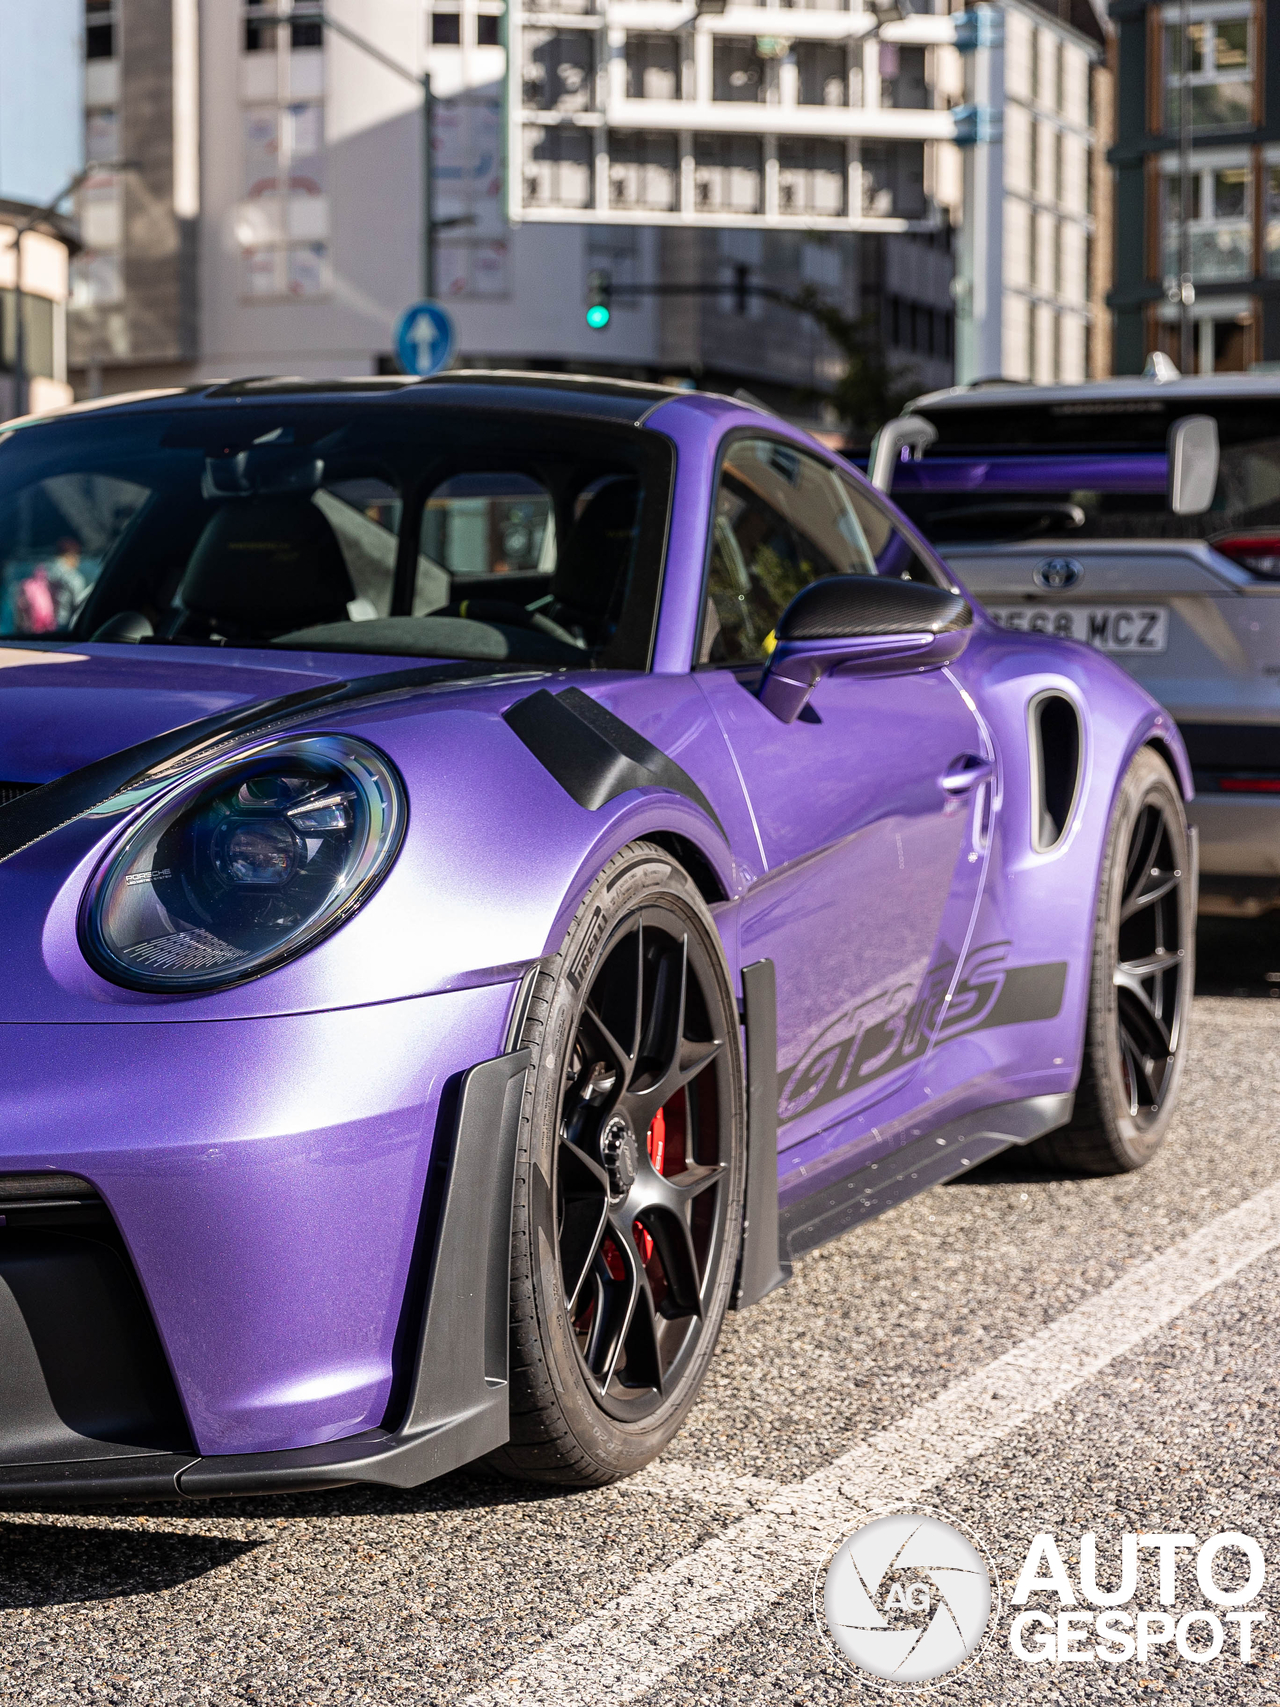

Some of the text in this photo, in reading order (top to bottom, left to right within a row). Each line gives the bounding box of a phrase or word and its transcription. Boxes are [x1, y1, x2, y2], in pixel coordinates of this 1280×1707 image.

[1087, 611, 1161, 647] MCZ
[125, 868, 171, 881] PORSCHE
[566, 905, 608, 993] PIRELLI
